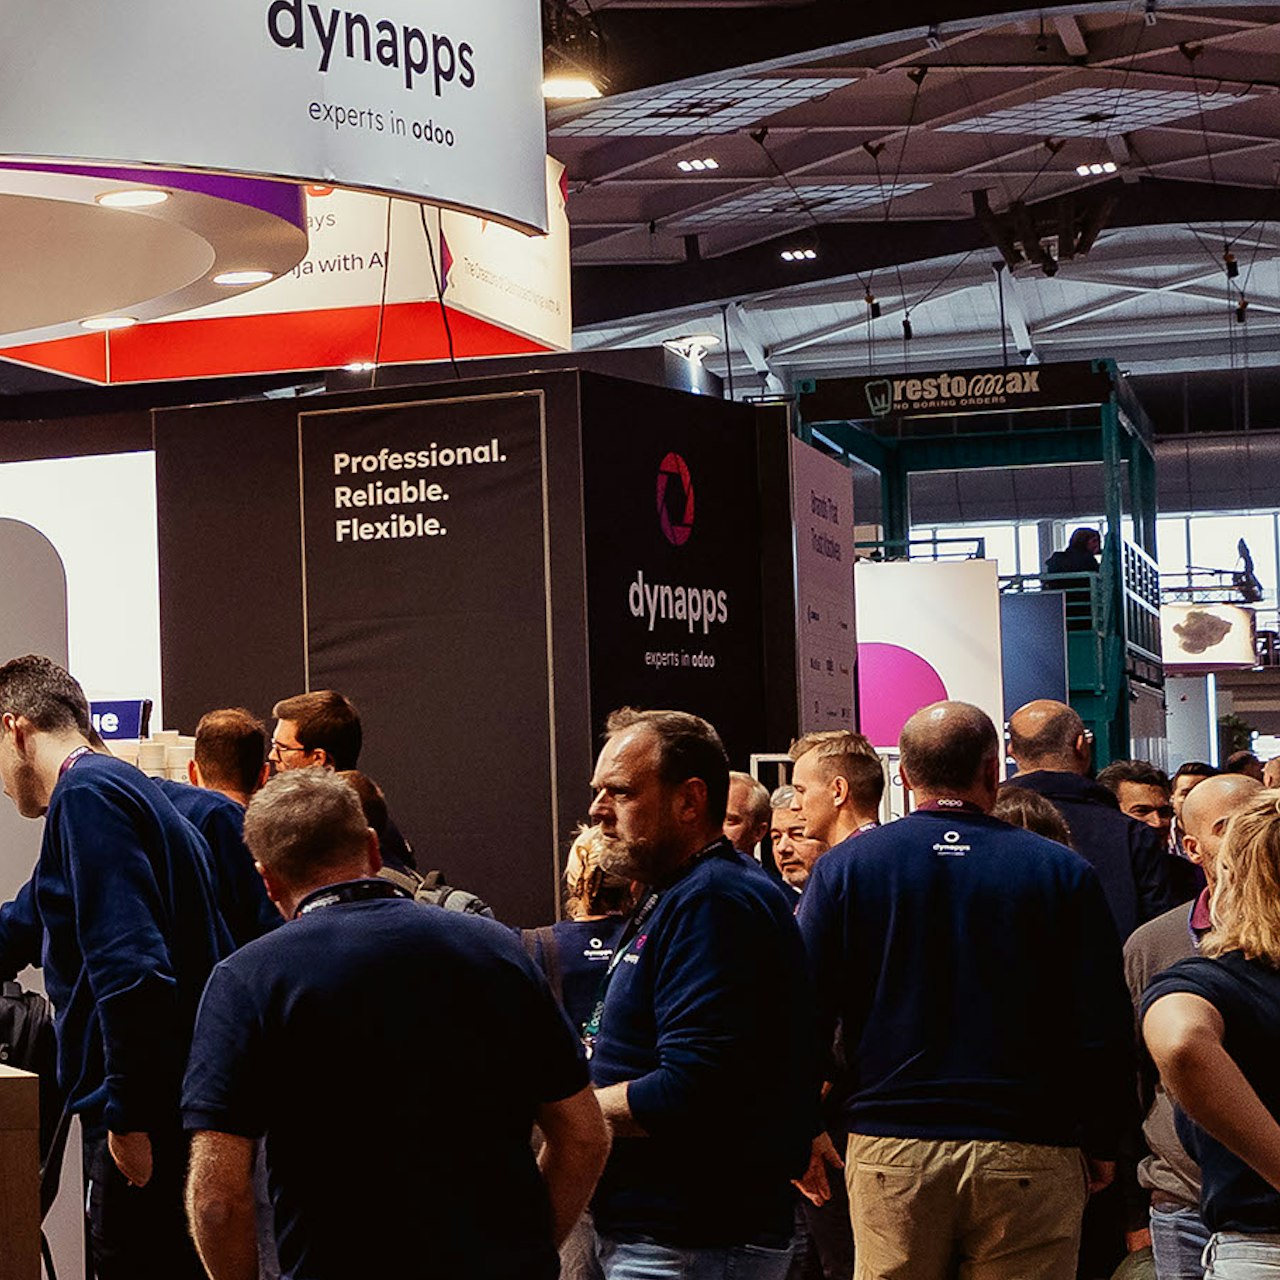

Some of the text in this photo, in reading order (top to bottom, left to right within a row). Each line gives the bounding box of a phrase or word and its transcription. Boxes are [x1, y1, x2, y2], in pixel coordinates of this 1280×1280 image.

[308, 102, 454, 147] experts in odoo
[306, 213, 336, 232] ays
[318, 253, 364, 273] with
[893, 370, 1040, 402] restomax
[893, 396, 1007, 410] NO BORING ORDERS
[334, 438, 507, 476] Professional.
[335, 478, 450, 509] Reliable.
[336, 513, 448, 543] Flexible.
[628, 569, 728, 635] dynapps
[645, 649, 715, 670] experts in odoo
[932, 843, 971, 852] dynapps
[590, 1000, 605, 1027] odoo
